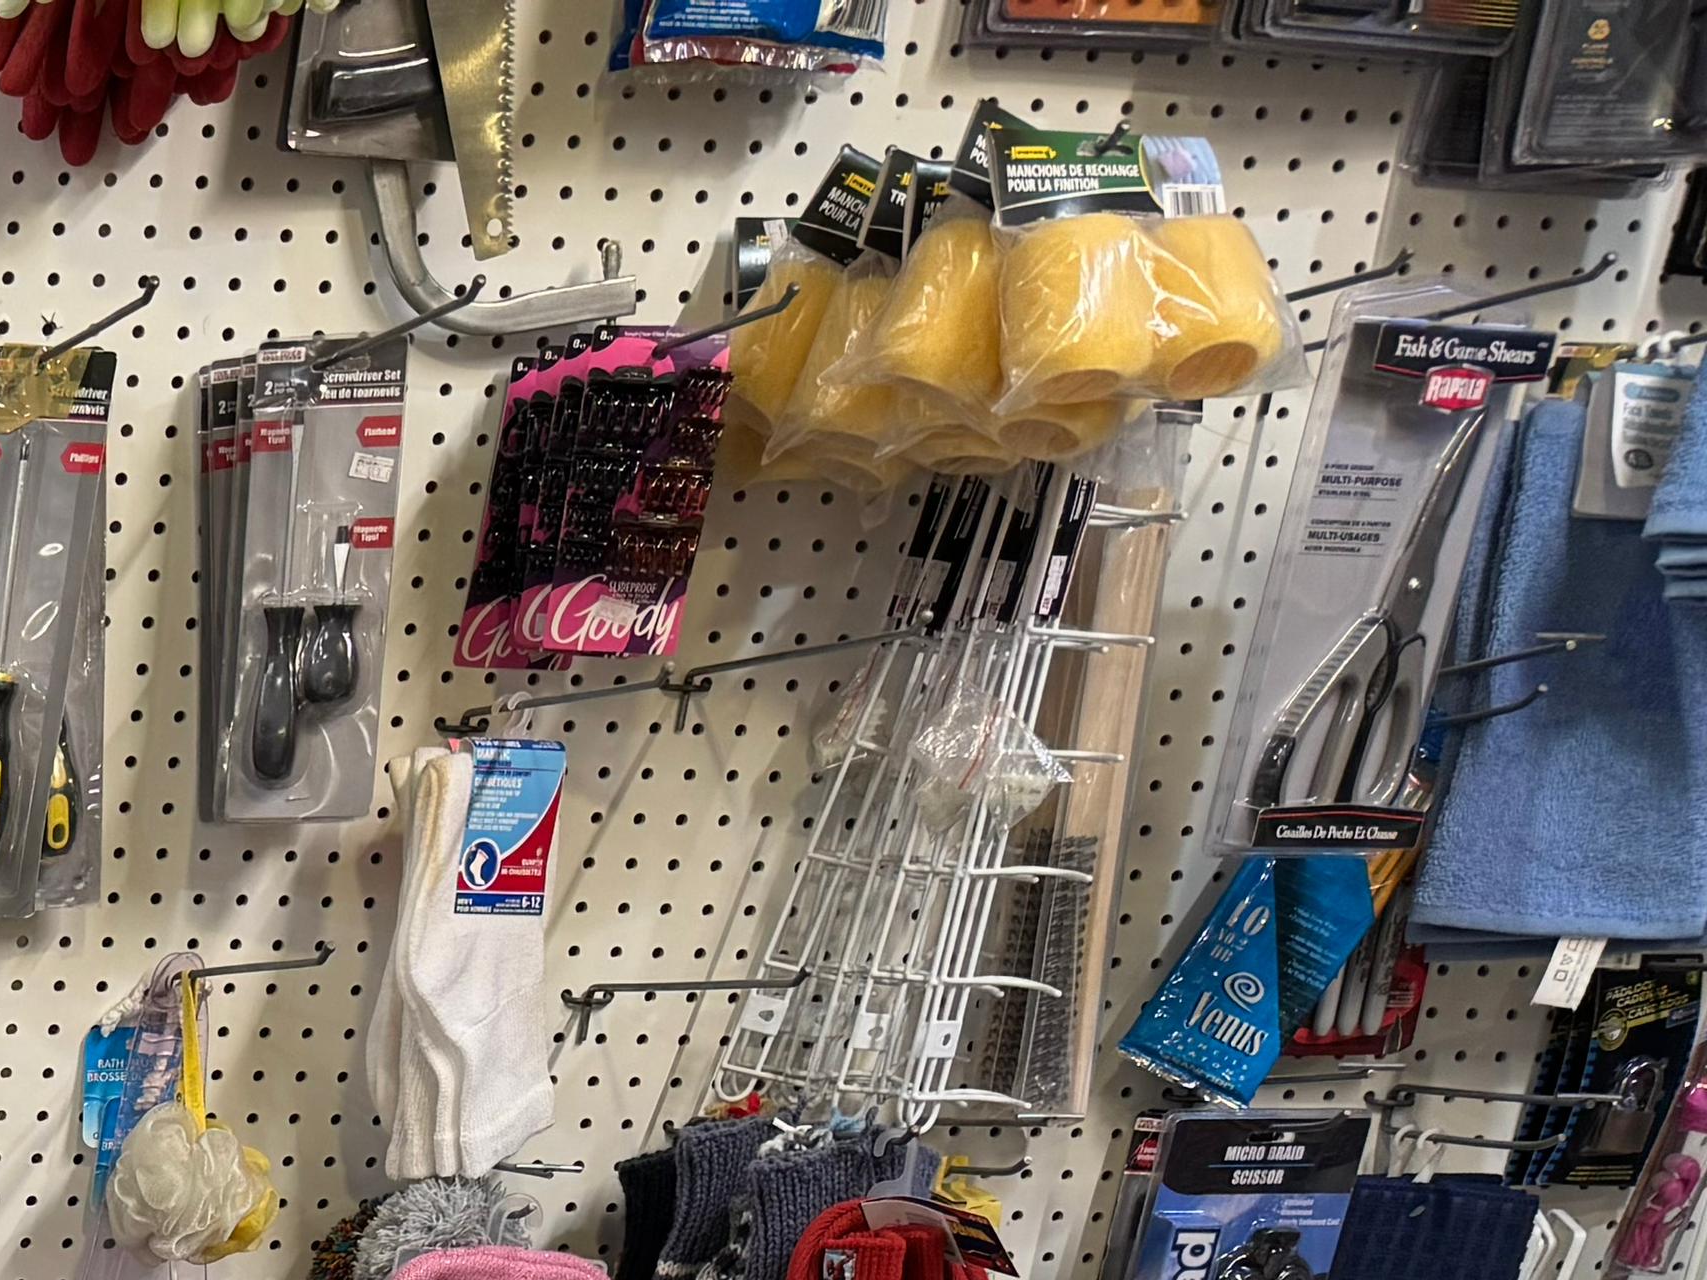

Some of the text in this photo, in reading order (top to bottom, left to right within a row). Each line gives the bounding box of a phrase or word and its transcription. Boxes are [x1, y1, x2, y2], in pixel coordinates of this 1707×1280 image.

[1007, 164, 1139, 178] MANCHONS DE RECHANGE
[1008, 178, 1099, 192] POUR LA FINITION
[1396, 335, 1535, 365] Fish & Game Shears
[324, 370, 400, 383] Screwdriver Set
[1321, 476, 1402, 487] MULTI-PURPOSE
[1307, 531, 1380, 542] MULTI-USAGES
[551, 574, 679, 655] Goody
[1226, 901, 1271, 936] 10
[1184, 991, 1268, 1057] Venus
[1225, 1146, 1305, 1161] MICRO BRAID
[1232, 1170, 1284, 1184] SCISSOR
